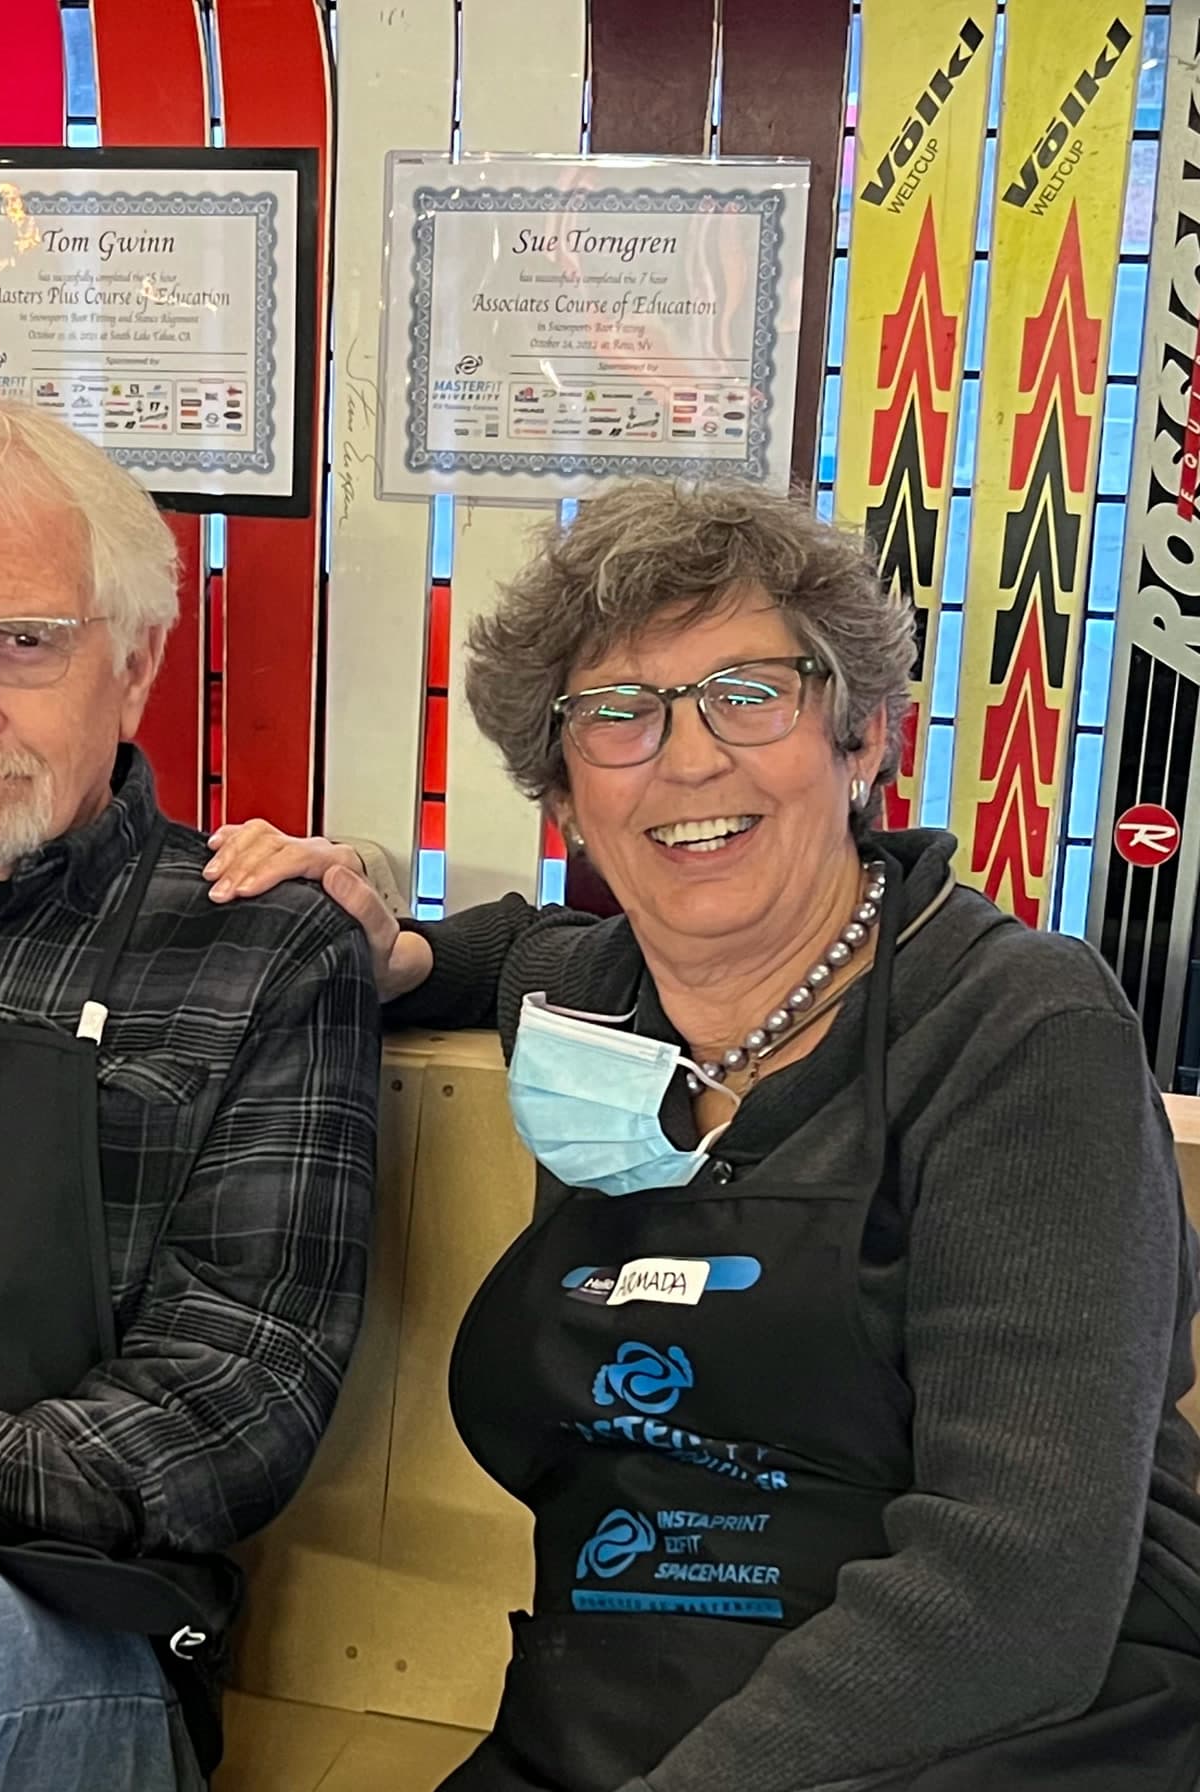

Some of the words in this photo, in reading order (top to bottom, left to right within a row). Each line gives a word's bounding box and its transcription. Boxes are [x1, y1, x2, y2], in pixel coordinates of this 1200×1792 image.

[888, 137, 940, 215] WELTCUP
[1030, 139, 1084, 217] WELTCUP
[42, 228, 88, 253] Tom
[99, 229, 175, 261] Gwinn
[512, 229, 558, 254] Sue
[566, 228, 677, 262] Torngren
[48, 282, 79, 304] Plus
[84, 286, 132, 305] Course
[154, 283, 230, 305] Education
[472, 293, 549, 313] Associates
[555, 295, 606, 314] Course
[612, 290, 631, 321] of
[632, 290, 717, 315] Education
[434, 380, 503, 392] MASTERFIT
[657, 1510, 770, 1532] INSTAPRINT
[654, 1562, 780, 1584] SPACEMAKER
